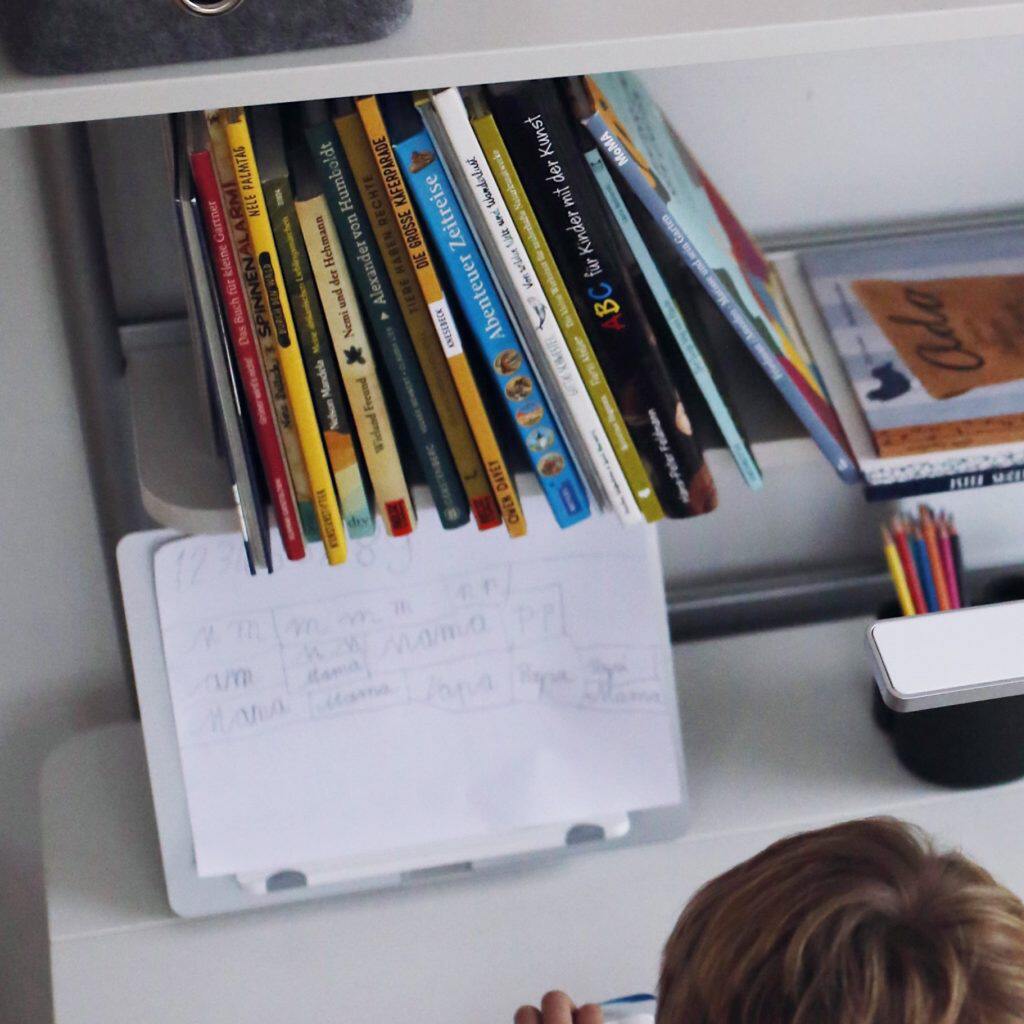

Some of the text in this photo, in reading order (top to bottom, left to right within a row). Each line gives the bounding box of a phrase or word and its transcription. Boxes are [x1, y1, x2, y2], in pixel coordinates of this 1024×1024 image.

[523, 112, 555, 159] Kunst
[597, 129, 630, 167] MoMA
[232, 146, 260, 217] NELE PALMTAG
[540, 157, 566, 187] der
[551, 184, 575, 210] mit
[317, 140, 388, 308] Alexander von Humboldt
[396, 208, 422, 249] GROSSE
[559, 207, 594, 259] Kinder
[216, 244, 233, 278] kleine
[311, 214, 355, 338] Nemi und der Hehmann
[412, 250, 430, 270] DIE
[420, 171, 506, 344] Abenteuer Zeitreise
[578, 255, 603, 279] für
[229, 297, 244, 325] Buch
[585, 279, 627, 336] ABC
[354, 376, 375, 412] Freund
